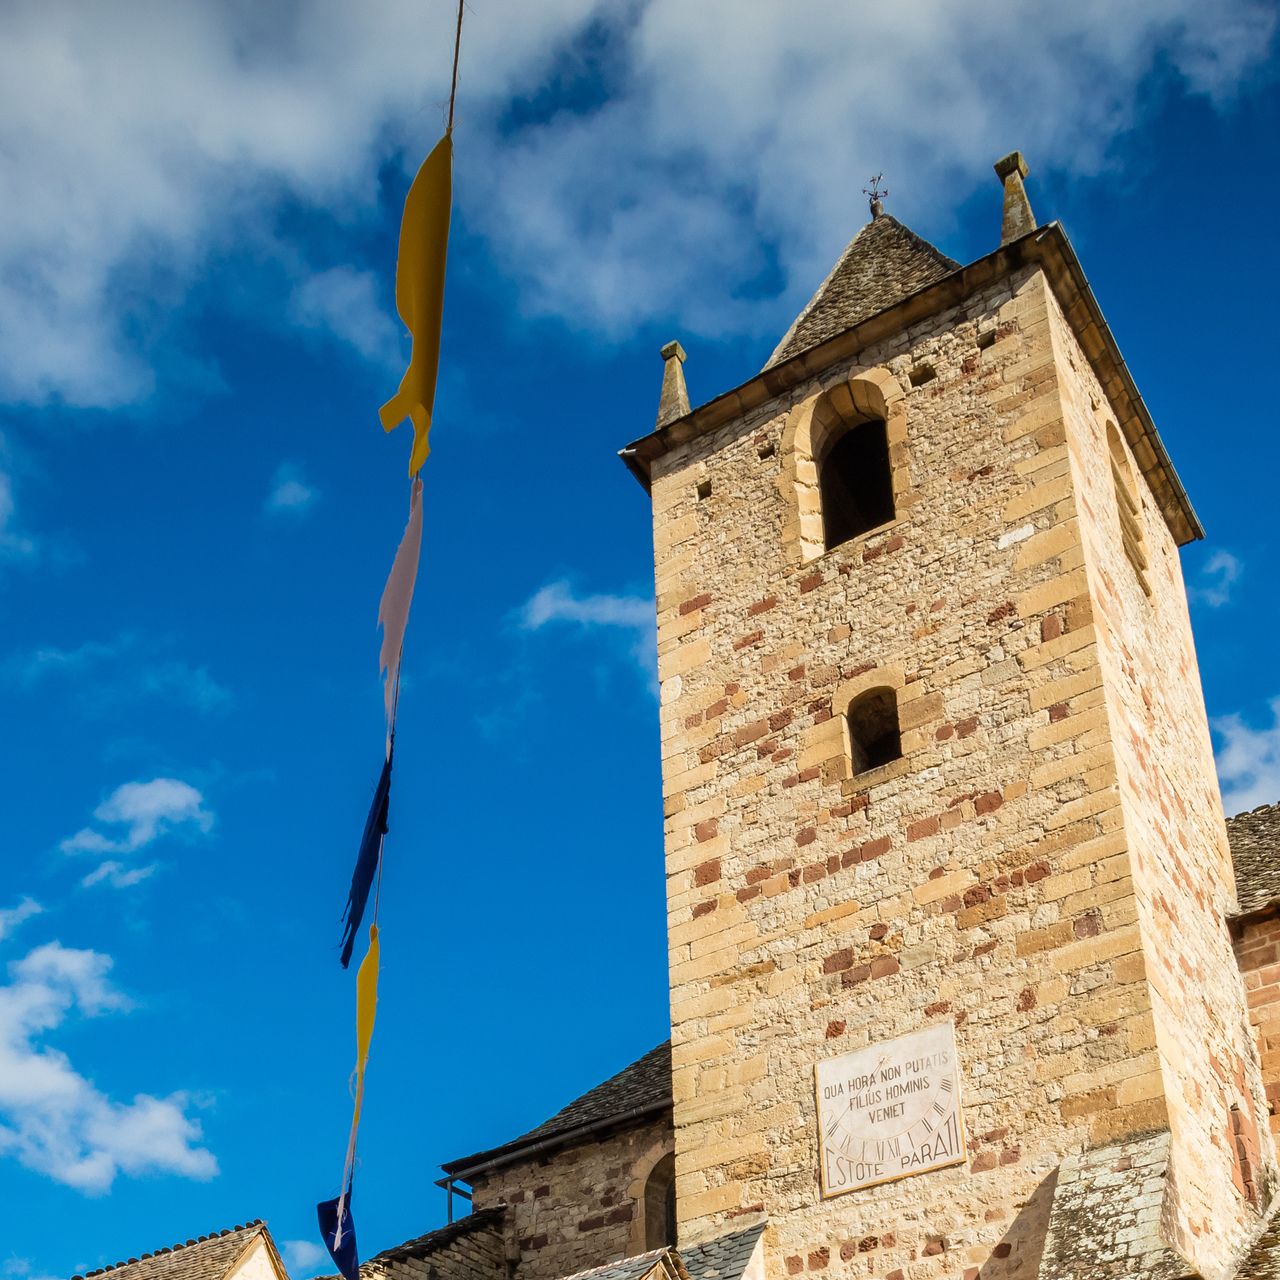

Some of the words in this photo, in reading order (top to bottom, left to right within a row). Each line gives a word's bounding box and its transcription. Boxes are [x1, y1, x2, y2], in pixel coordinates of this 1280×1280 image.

[824, 1084, 844, 1100] QUA
[848, 1073, 877, 1092] HORA
[880, 1065, 901, 1083] NON
[905, 1051, 949, 1076] PUTATIS
[849, 1090, 882, 1112] FILIUS
[885, 1076, 931, 1101] HOMINIS
[868, 1102, 905, 1124] VENIET
[826, 1147, 885, 1189] ESTOTE
[900, 1111, 960, 1169] PARATI
